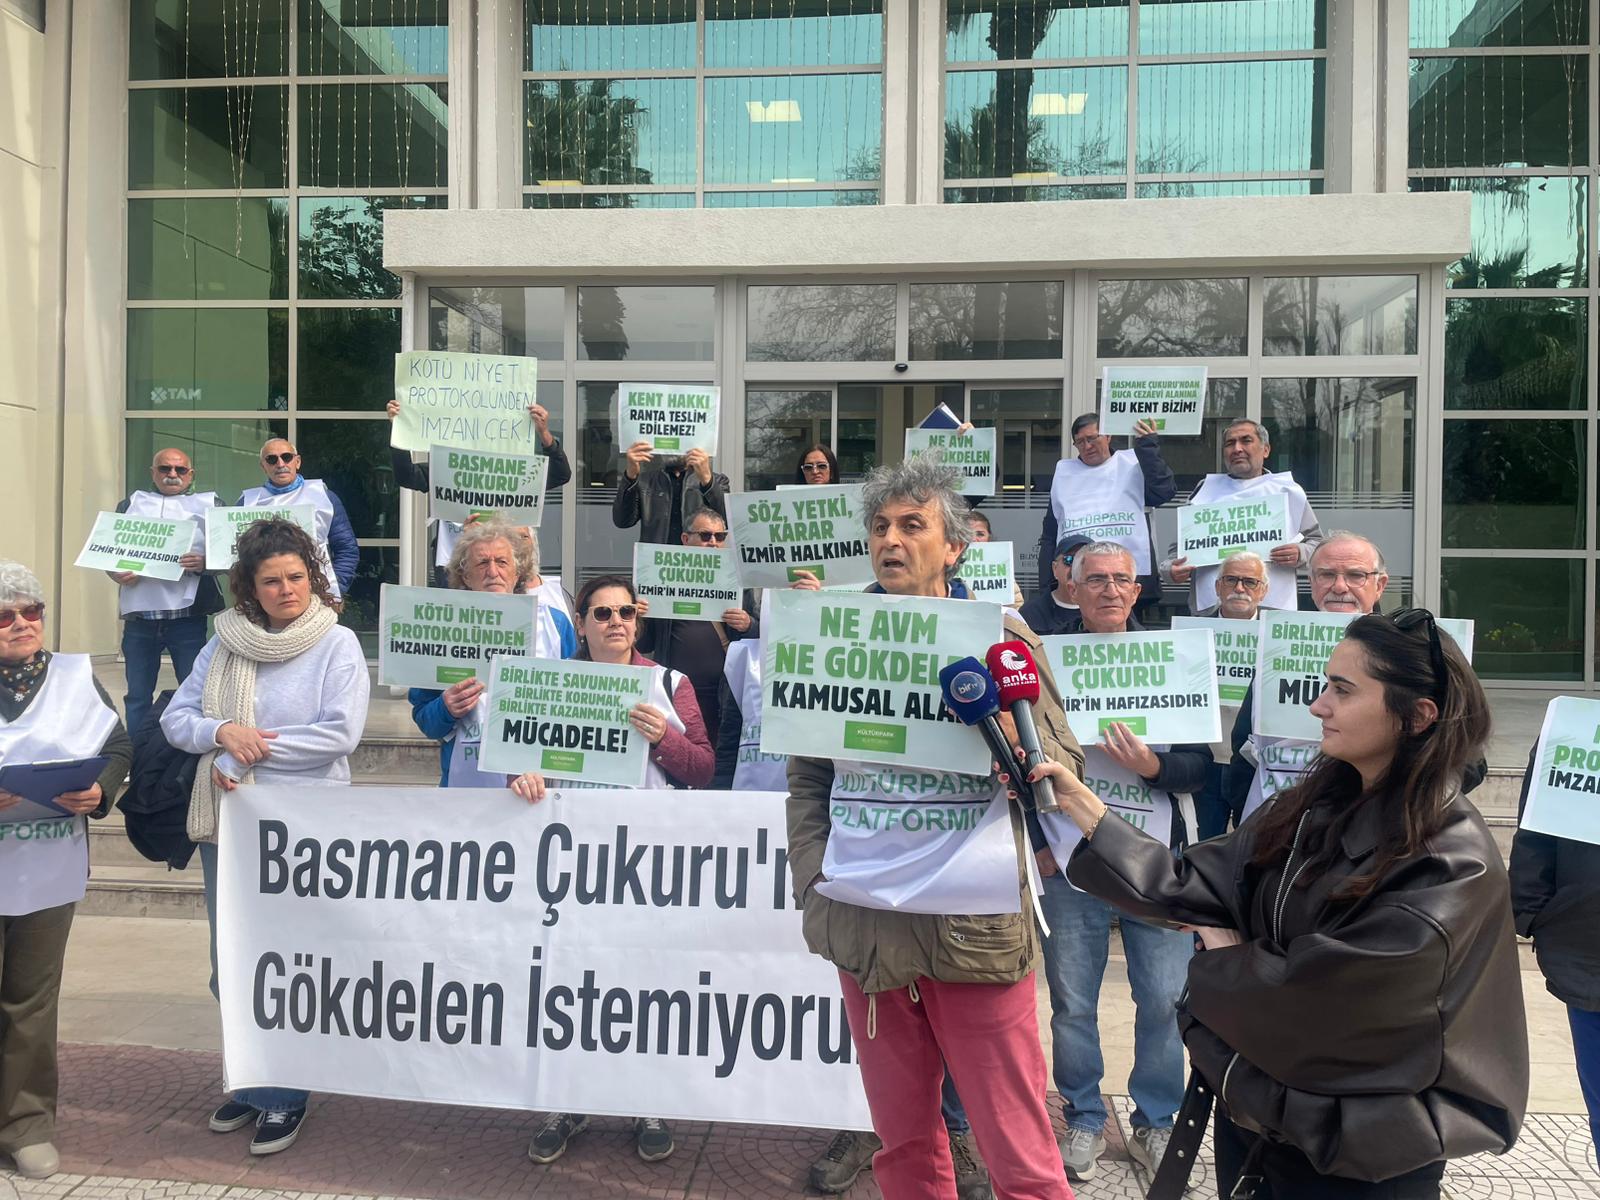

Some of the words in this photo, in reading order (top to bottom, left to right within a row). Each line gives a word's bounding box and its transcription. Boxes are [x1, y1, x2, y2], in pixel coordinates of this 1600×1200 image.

[464, 358, 519, 383] NİYET
[167, 387, 202, 401] TAM
[1110, 380, 1147, 389] BASMANE
[1148, 379, 1200, 391] ÇUKURU'NDAN
[1111, 389, 1132, 398] BUCA
[1133, 388, 1164, 398] CEZAEVİ
[1166, 388, 1197, 398] ALANINA
[628, 391, 664, 407] KENT
[667, 392, 710, 409] HAKKI
[1110, 402, 1127, 413] BU
[1130, 401, 1160, 413] KENT
[1161, 398, 1196, 413] BİZİM!
[420, 413, 479, 441] İMZANI
[629, 409, 665, 422] RANTA
[669, 409, 707, 423] TESLİM
[639, 421, 696, 437] EDİLEMEZ!
[929, 435, 945, 447] NE
[949, 435, 973, 448] AVM
[448, 452, 527, 476] BASMANE
[453, 471, 519, 492] ÇUKURU
[435, 486, 539, 508] KAMUNUNDUR!
[747, 499, 788, 526] SÖZ,
[792, 493, 853, 520] YETKİ,
[1194, 508, 1224, 524] SÖZ,
[1227, 501, 1271, 518] YETKİ,
[113, 518, 176, 537] BASMANE
[769, 520, 834, 543] KARAR
[1208, 518, 1257, 534] KARAR
[88, 543, 125, 557] İZMİR'İN
[114, 531, 166, 549] ÇUKURU
[1184, 535, 1220, 551] İZMİR
[1222, 529, 1282, 546] HALKINA!
[654, 550, 721, 570] BASMANE
[740, 543, 785, 564] İZMİR
[791, 539, 870, 562] HALKINA!
[658, 567, 715, 585] ÇUKURU
[973, 579, 1007, 591] ALAN!
[638, 584, 675, 596] İZMİR'İN
[678, 588, 737, 601] HAFIZASIDIR!
[414, 602, 454, 622] KÖTÜ
[459, 606, 503, 626] NİYET
[391, 622, 525, 647] PROTOKOLÜNDEN
[820, 606, 860, 639] NE
[869, 609, 938, 645] AVM
[1271, 621, 1345, 642] BİRLİKTE
[390, 638, 447, 657] İMZANIZI
[450, 644, 481, 660] GERİ
[1062, 641, 1175, 667] BASMANE
[1290, 641, 1335, 658] BİRLİK
[775, 642, 815, 675] NE
[824, 641, 965, 686] GÖKDEL
[499, 664, 560, 688] BİRLİKTE
[562, 671, 643, 697] SAVUNMAK,
[1002, 671, 1037, 684] anka
[1071, 664, 1166, 695] ÇUKURU
[514, 684, 562, 703] BİRLİKTE
[565, 690, 624, 709] KORUMAK,
[771, 680, 896, 717] KAMUSAL
[1106, 693, 1208, 710] HAFIZASIDIR!
[498, 697, 547, 716] BİRLİKTE
[549, 702, 614, 721] KAZANMAK
[502, 715, 629, 754] MÜCADELE!
[834, 768, 993, 794] KÜLTÜRPARK
[257, 817, 515, 903] Basmane
[252, 950, 503, 1046] Gökdelen
[526, 946, 860, 1080] İstemiyoru
